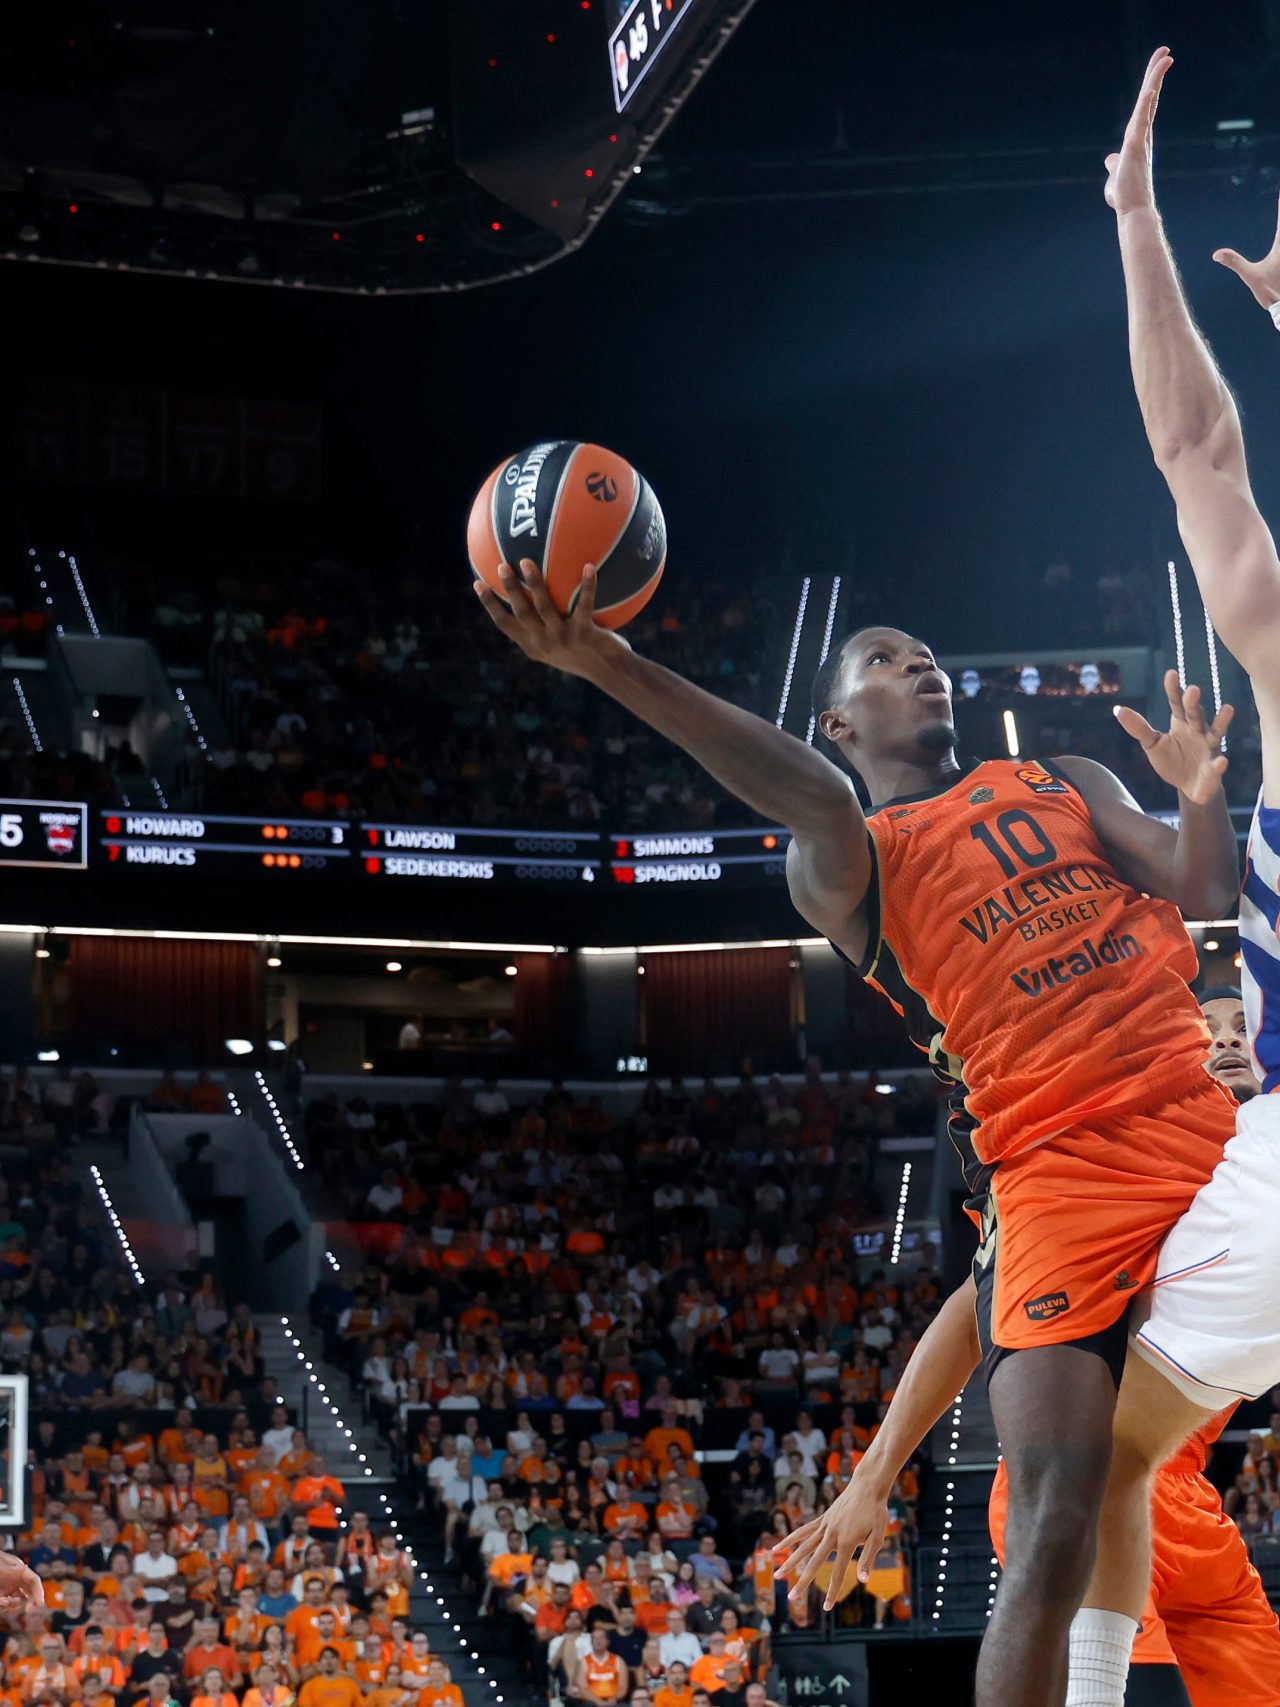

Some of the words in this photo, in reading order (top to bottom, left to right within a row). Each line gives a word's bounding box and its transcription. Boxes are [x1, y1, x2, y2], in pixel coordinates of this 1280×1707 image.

[0, 813, 24, 847] 5
[126, 816, 205, 838] HOWARD
[331, 826, 344, 845] 3
[385, 830, 456, 850] LAWSON
[107, 844, 120, 862] 7
[126, 845, 197, 866] KURUCS
[633, 838, 714, 857] SIMMONS
[970, 808, 1058, 881] 10
[385, 857, 494, 879] SEDEKERSKIS
[581, 865, 595, 882] 4
[634, 862, 722, 884] SPAGNOLO
[958, 865, 1126, 945] VALENCIA
[1018, 899, 1101, 943] BASKET
[1028, 1297, 1066, 1314] PULEVA
